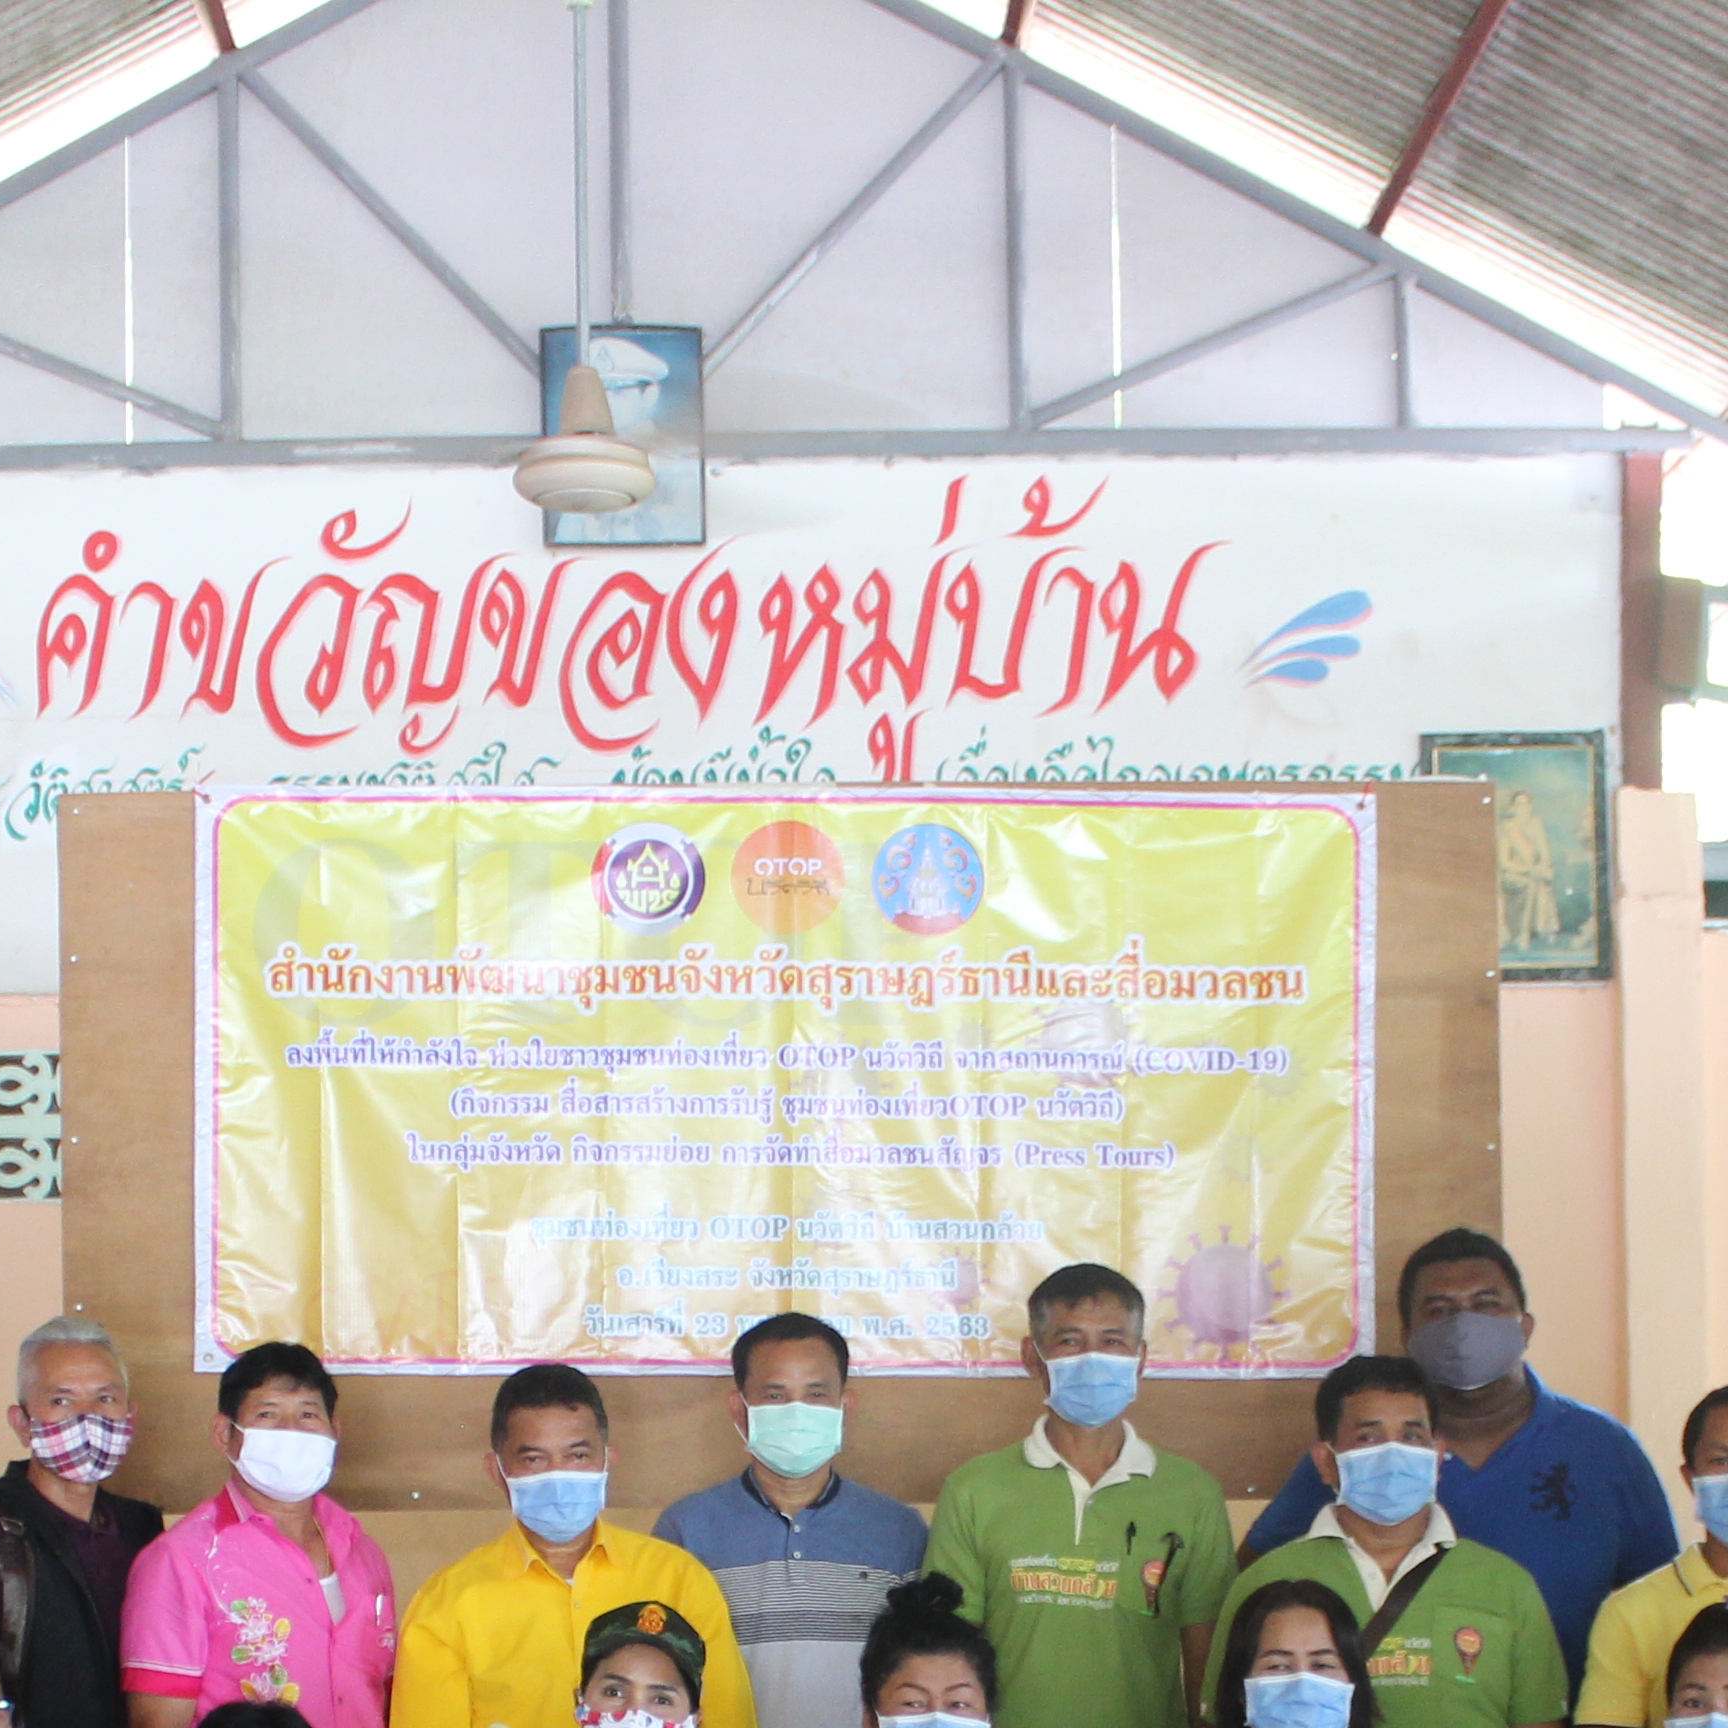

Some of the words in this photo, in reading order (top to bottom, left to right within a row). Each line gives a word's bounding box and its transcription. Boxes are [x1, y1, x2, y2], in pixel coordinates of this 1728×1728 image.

[36, 476, 1231, 782] คำขวัญของหมู่บ้าน
[754, 857, 822, 877] OTOP
[268, 938, 1305, 1008] สำนักงานพัฒนาชุมชนจังหวัดสุราษฎร์ธานีและสื่อมวลชน
[287, 1030, 477, 1067] ลงพื้นที่ให้กำลังใจ
[489, 1032, 769, 1075] ห่วงใยชาวชุมชนท่องเที่ยว
[778, 1044, 855, 1069] OTOP
[865, 1041, 943, 1069] นวัตวิถี
[957, 1043, 1122, 1071] จากสถานการณ์
[1133, 1044, 1288, 1074] (COVID-19)
[450, 1089, 548, 1118] (กิจกรรม
[561, 1079, 772, 1123] สื่อสารสร้างการรับรู้
[1037, 1089, 1123, 1121] นวัตวิถี)
[407, 1133, 560, 1171] ในกลุ่มจังหวัด
[572, 1137, 710, 1163] กิจกรรมย่อย
[722, 1128, 1000, 1171] การจัดทำสื่อมวลชนสัญจร
[1014, 1143, 1086, 1169] (Press
[1095, 1143, 1175, 1169] Tours)
[531, 1205, 697, 1246] ชุมชนท่องเที่ยว
[710, 1215, 788, 1240] OTOP
[797, 1211, 875, 1241] นวัตวิถี
[886, 1211, 1042, 1241] บ้านสวนกล้วย
[618, 1261, 739, 1290] อ.เวียงสระ
[748, 1259, 957, 1296] จังหวัดสุราษฎร์ธานี
[583, 1301, 684, 1337] วันเสาร์ที่
[697, 1314, 725, 1338] 23
[862, 1313, 912, 1337] พ.ศ.
[927, 1314, 989, 1338] 2563
